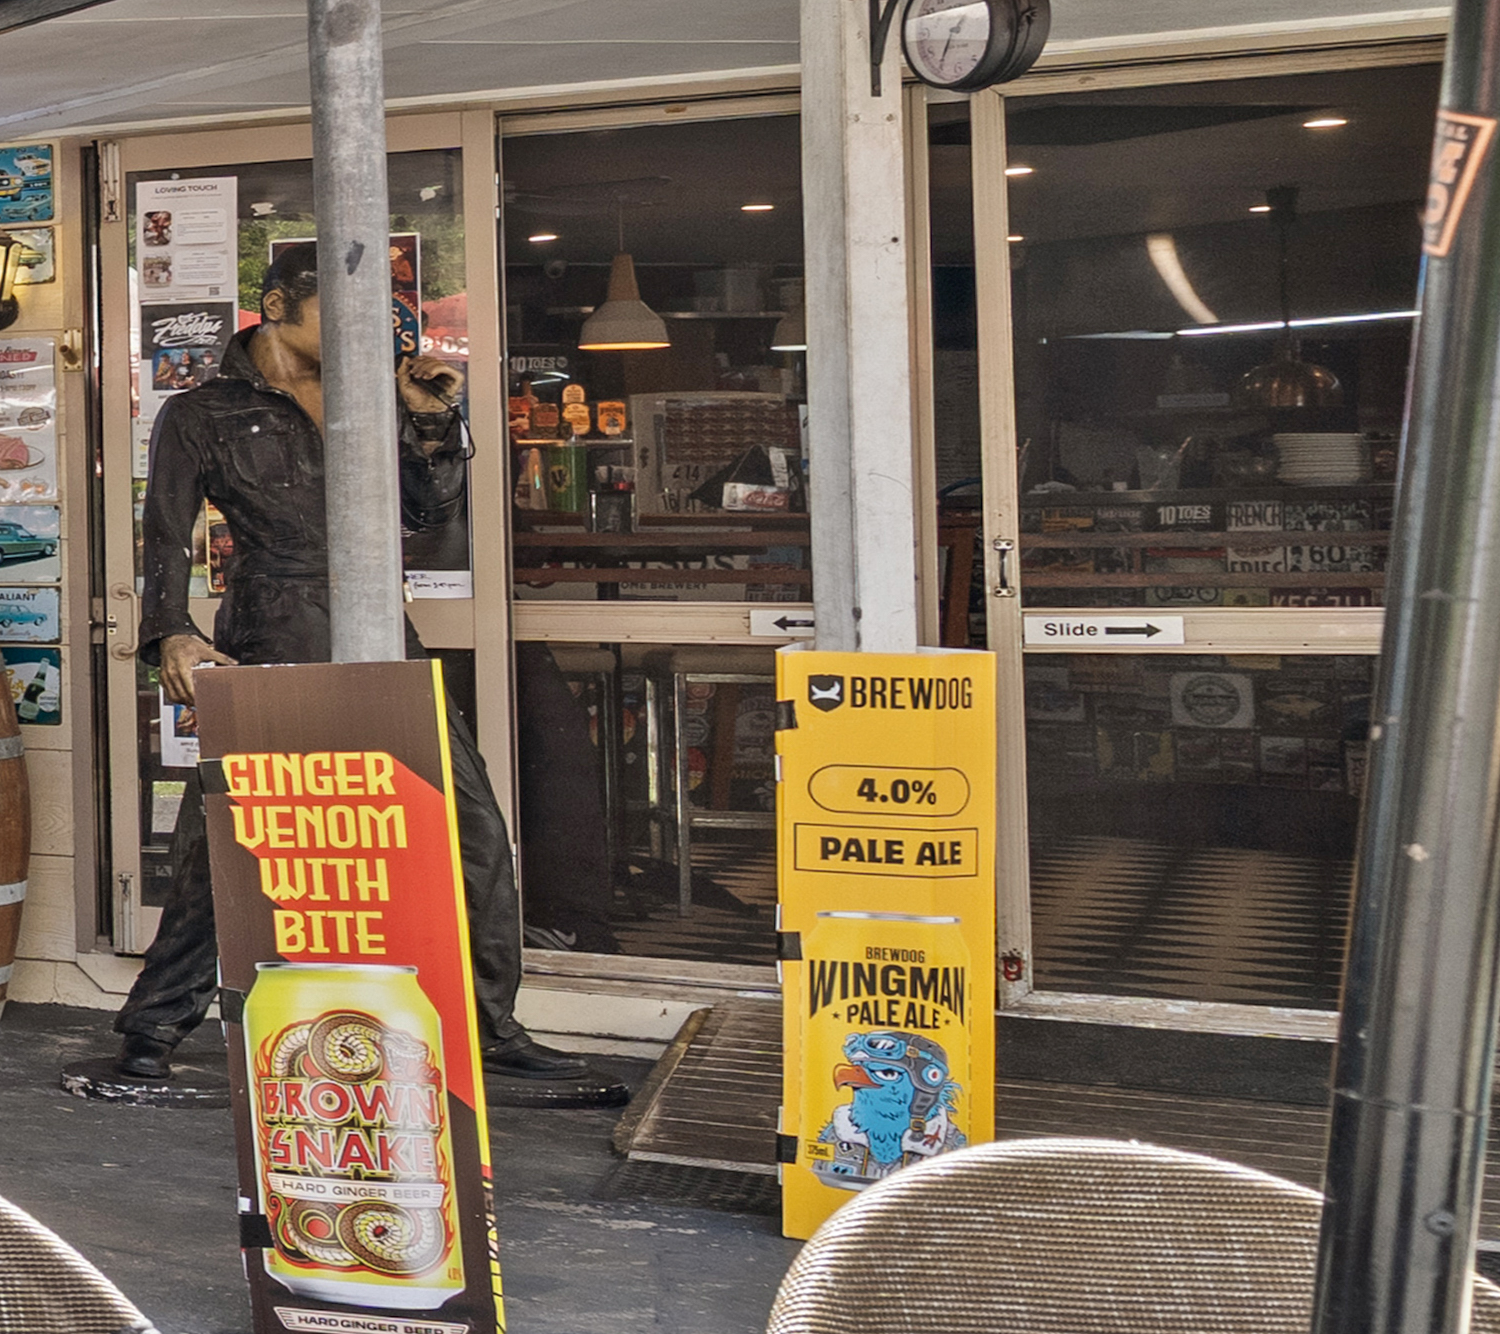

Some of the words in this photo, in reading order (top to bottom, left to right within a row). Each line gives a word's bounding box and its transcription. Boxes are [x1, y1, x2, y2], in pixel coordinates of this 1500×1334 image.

[154, 185, 187, 195] LOVING
[187, 183, 219, 193] TOUCH
[1157, 505, 1175, 525] 10
[1177, 504, 1212, 520] TOES
[1043, 622, 1099, 638] Slide
[850, 676, 973, 711] BREWDOG
[222, 751, 397, 798] GINGER
[857, 778, 937, 805] 4.0%
[228, 803, 408, 849] VENOM
[820, 835, 904, 865] PALE
[915, 840, 963, 867] ALE
[258, 857, 390, 902] WITH
[272, 909, 387, 955] BITE
[865, 946, 926, 964] BREWDOG
[808, 958, 966, 1028] WINGMAN
[846, 999, 901, 1028] PALE
[903, 1000, 941, 1030] ALE
[260, 1077, 442, 1127] BROWN
[268, 1127, 438, 1175] SNAKE
[282, 1179, 327, 1196] HARD
[332, 1184, 388, 1200] GINGER
[392, 1187, 432, 1201] BEER
[297, 1314, 341, 1329] HARD
[340, 1318, 399, 1334] GINGER
